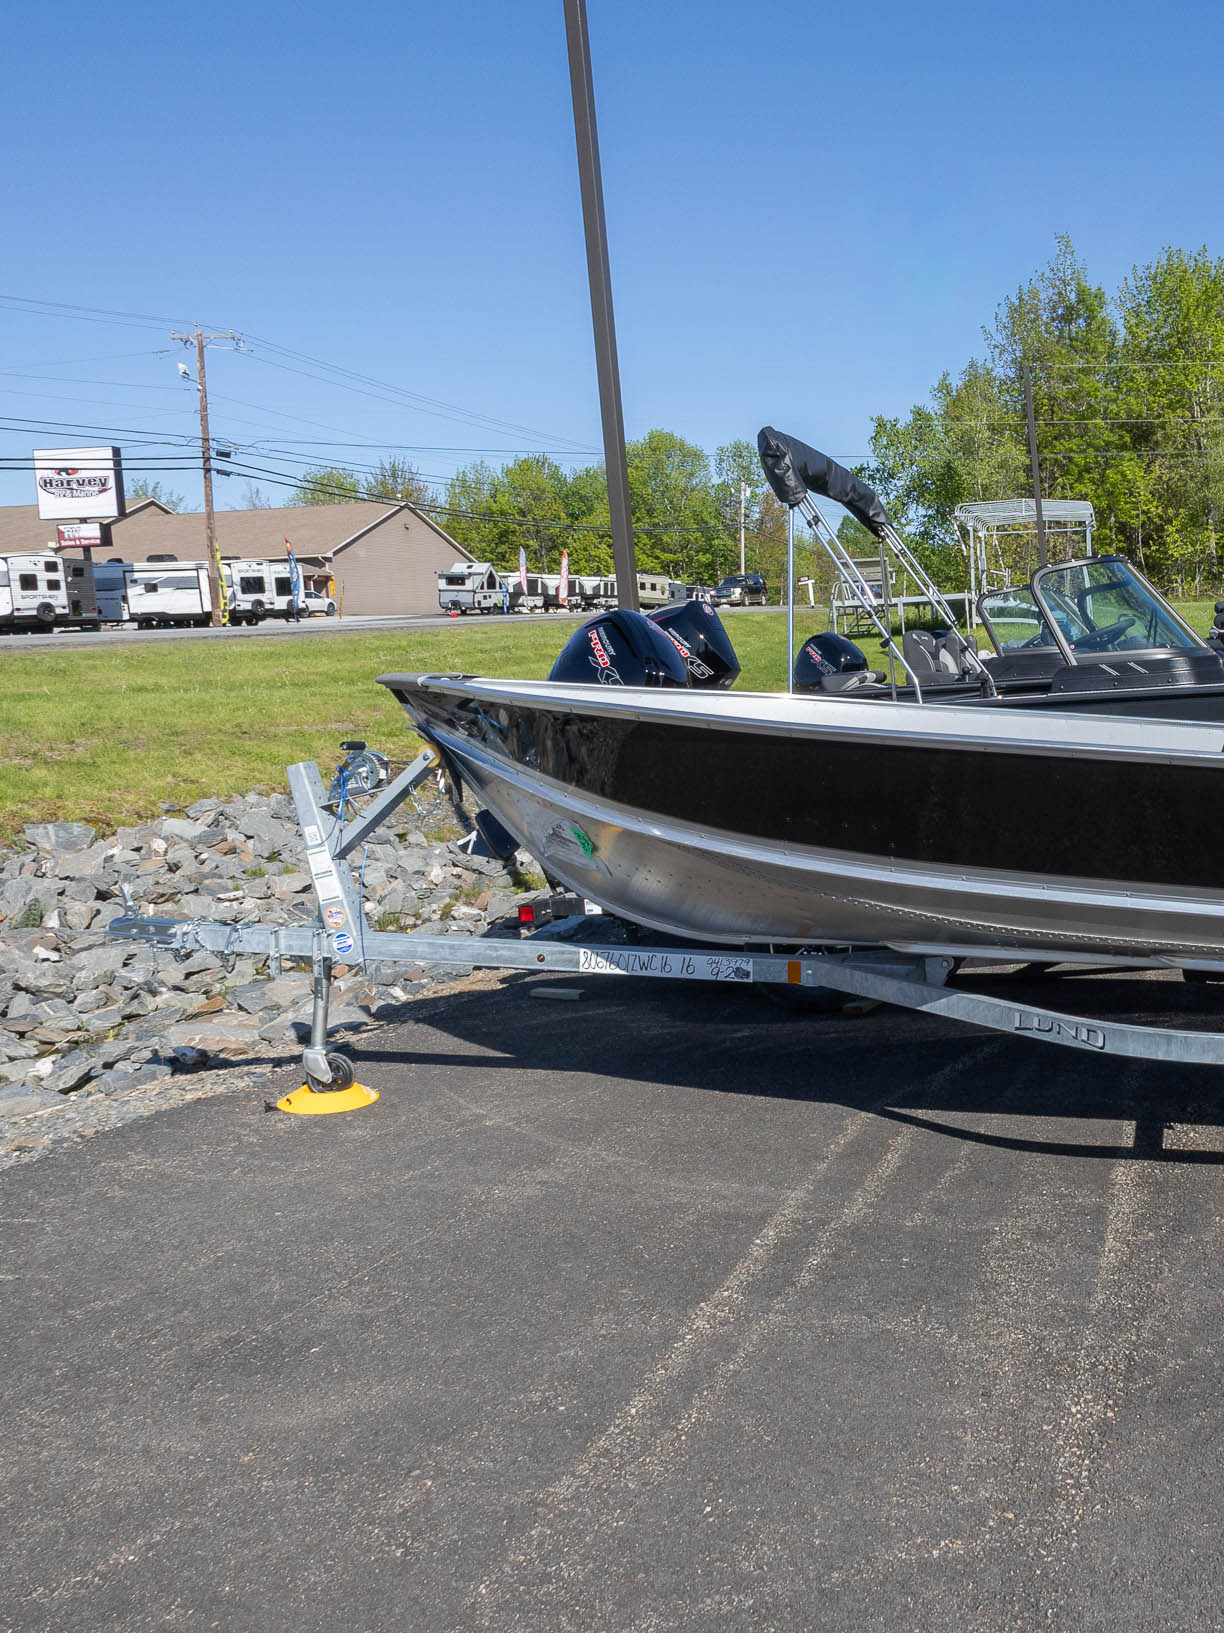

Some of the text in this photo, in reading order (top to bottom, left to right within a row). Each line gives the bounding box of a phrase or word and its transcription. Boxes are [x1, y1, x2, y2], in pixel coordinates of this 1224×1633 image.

[42, 477, 108, 489] Harvey
[63, 527, 80, 538] RV
[588, 630, 610, 667] PRO
[597, 626, 616, 656] MERCURY
[1014, 1012, 1106, 1051] LUND
